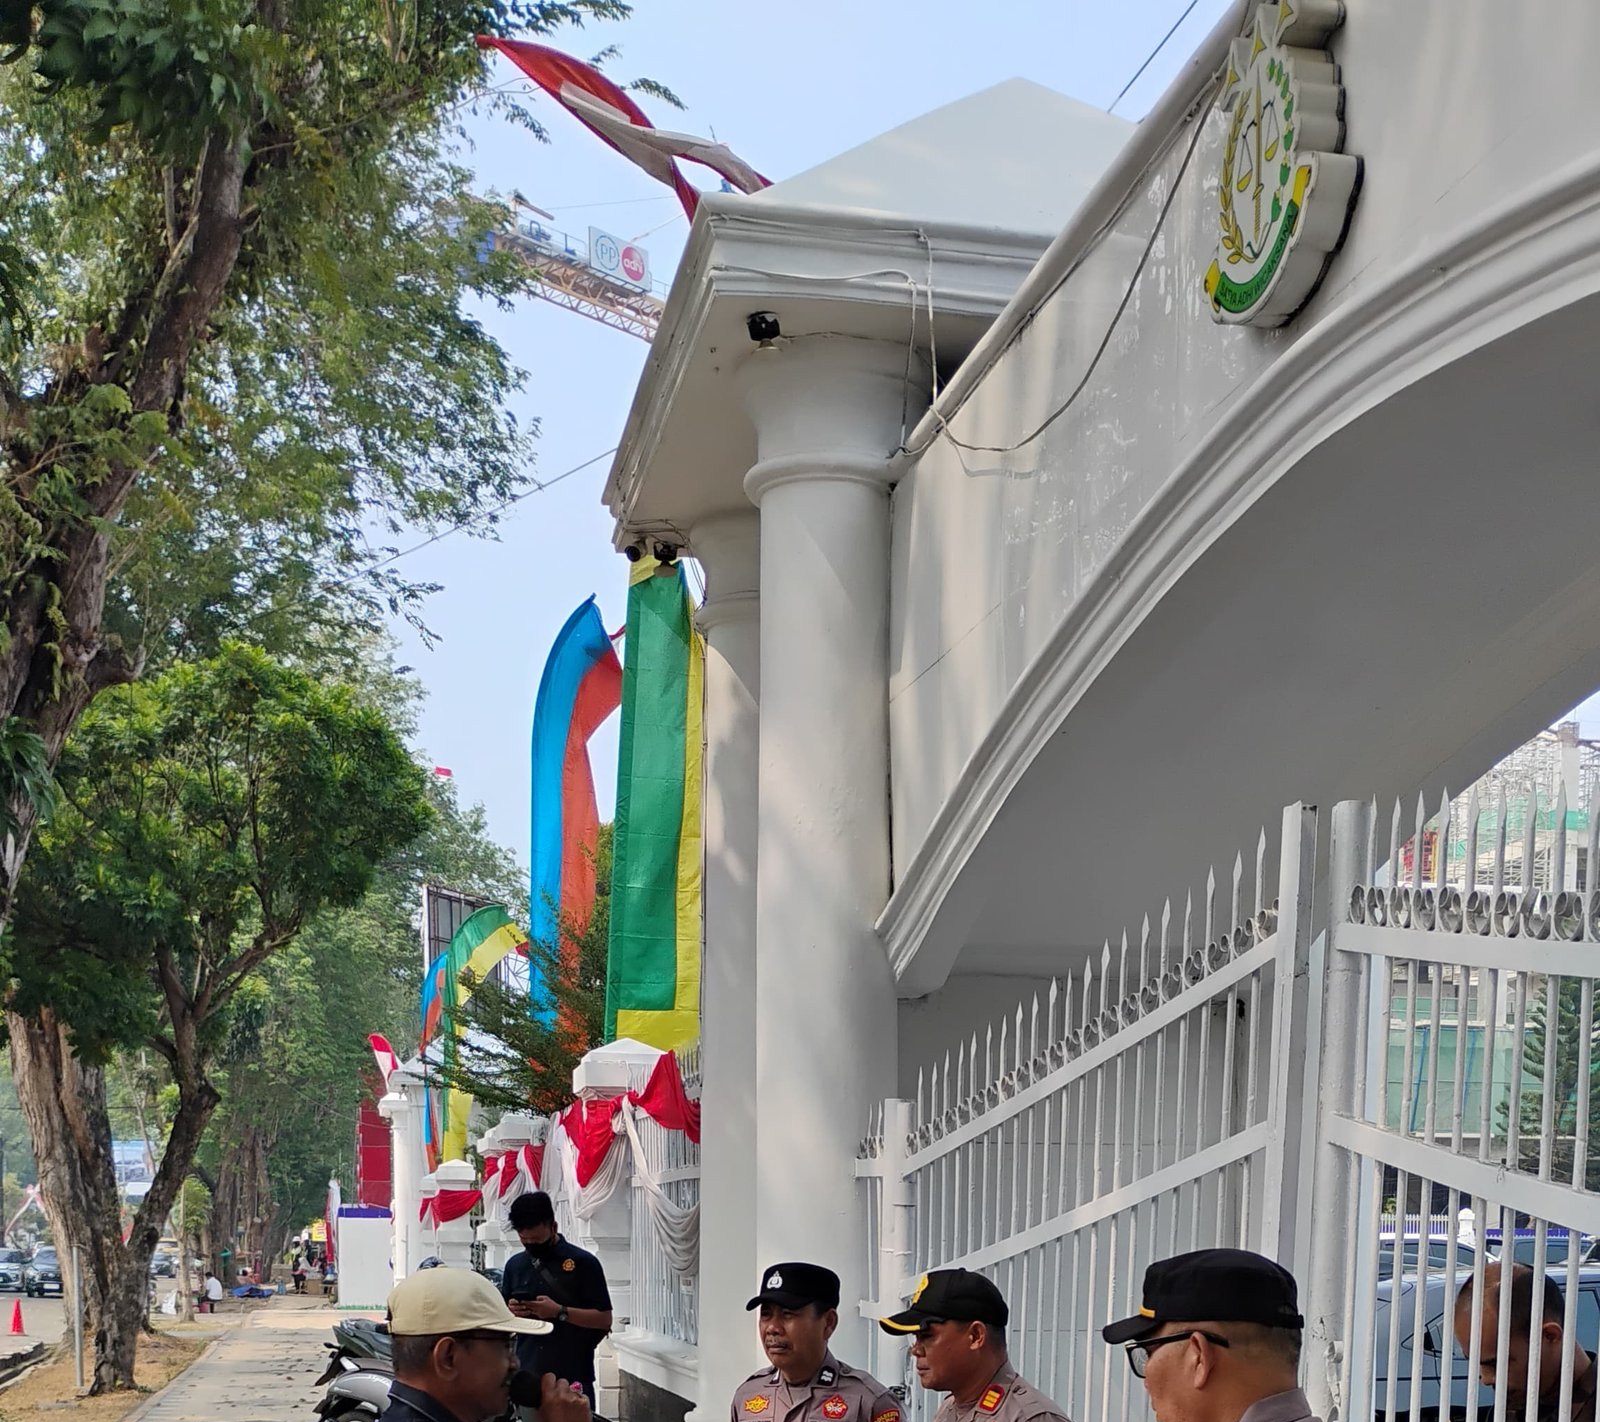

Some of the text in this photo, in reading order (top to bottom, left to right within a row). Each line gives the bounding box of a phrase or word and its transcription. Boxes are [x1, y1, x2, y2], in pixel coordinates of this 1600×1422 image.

[601, 243, 616, 263] PP
[1220, 214, 1296, 305] SATYA ADHI WICAKSANA
